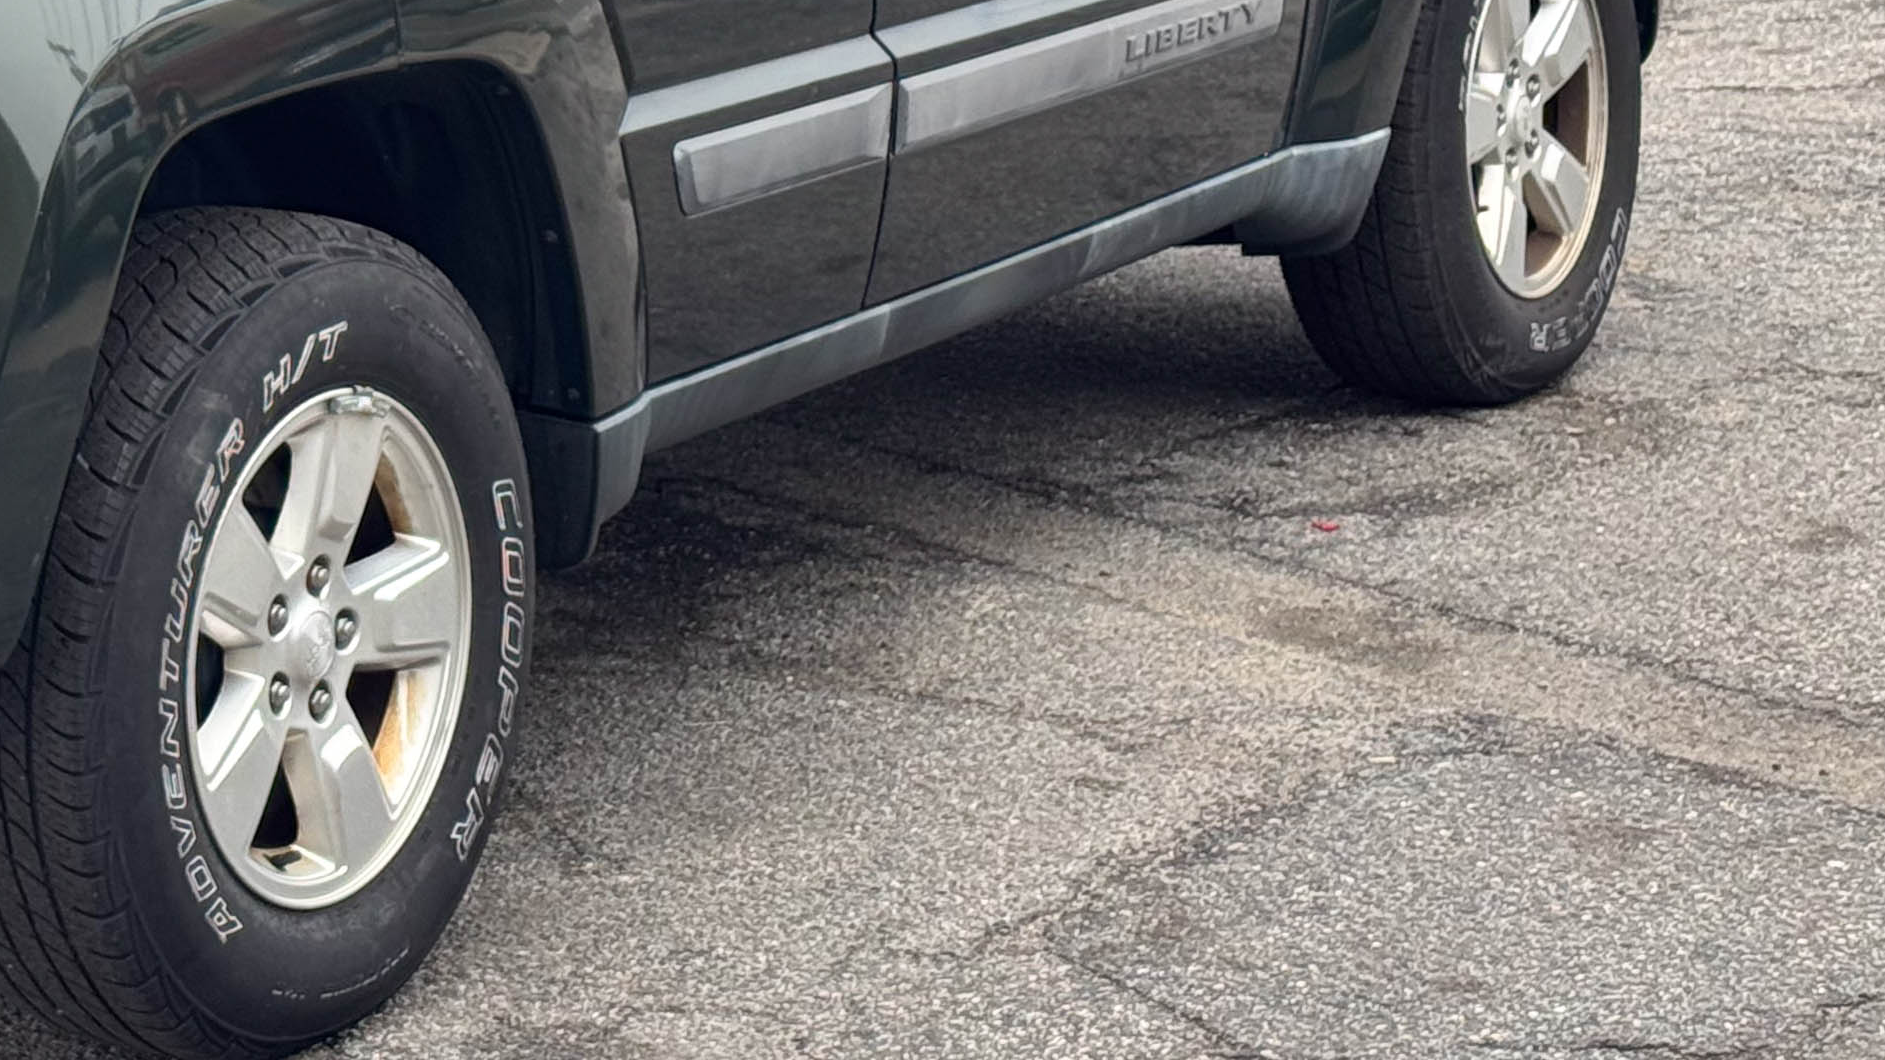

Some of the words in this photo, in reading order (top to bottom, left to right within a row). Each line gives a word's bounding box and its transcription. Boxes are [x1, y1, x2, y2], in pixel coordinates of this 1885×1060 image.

[158, 417, 246, 943] ADVENTURER
[263, 321, 348, 413] H/T
[450, 478, 525, 862] COOPER
